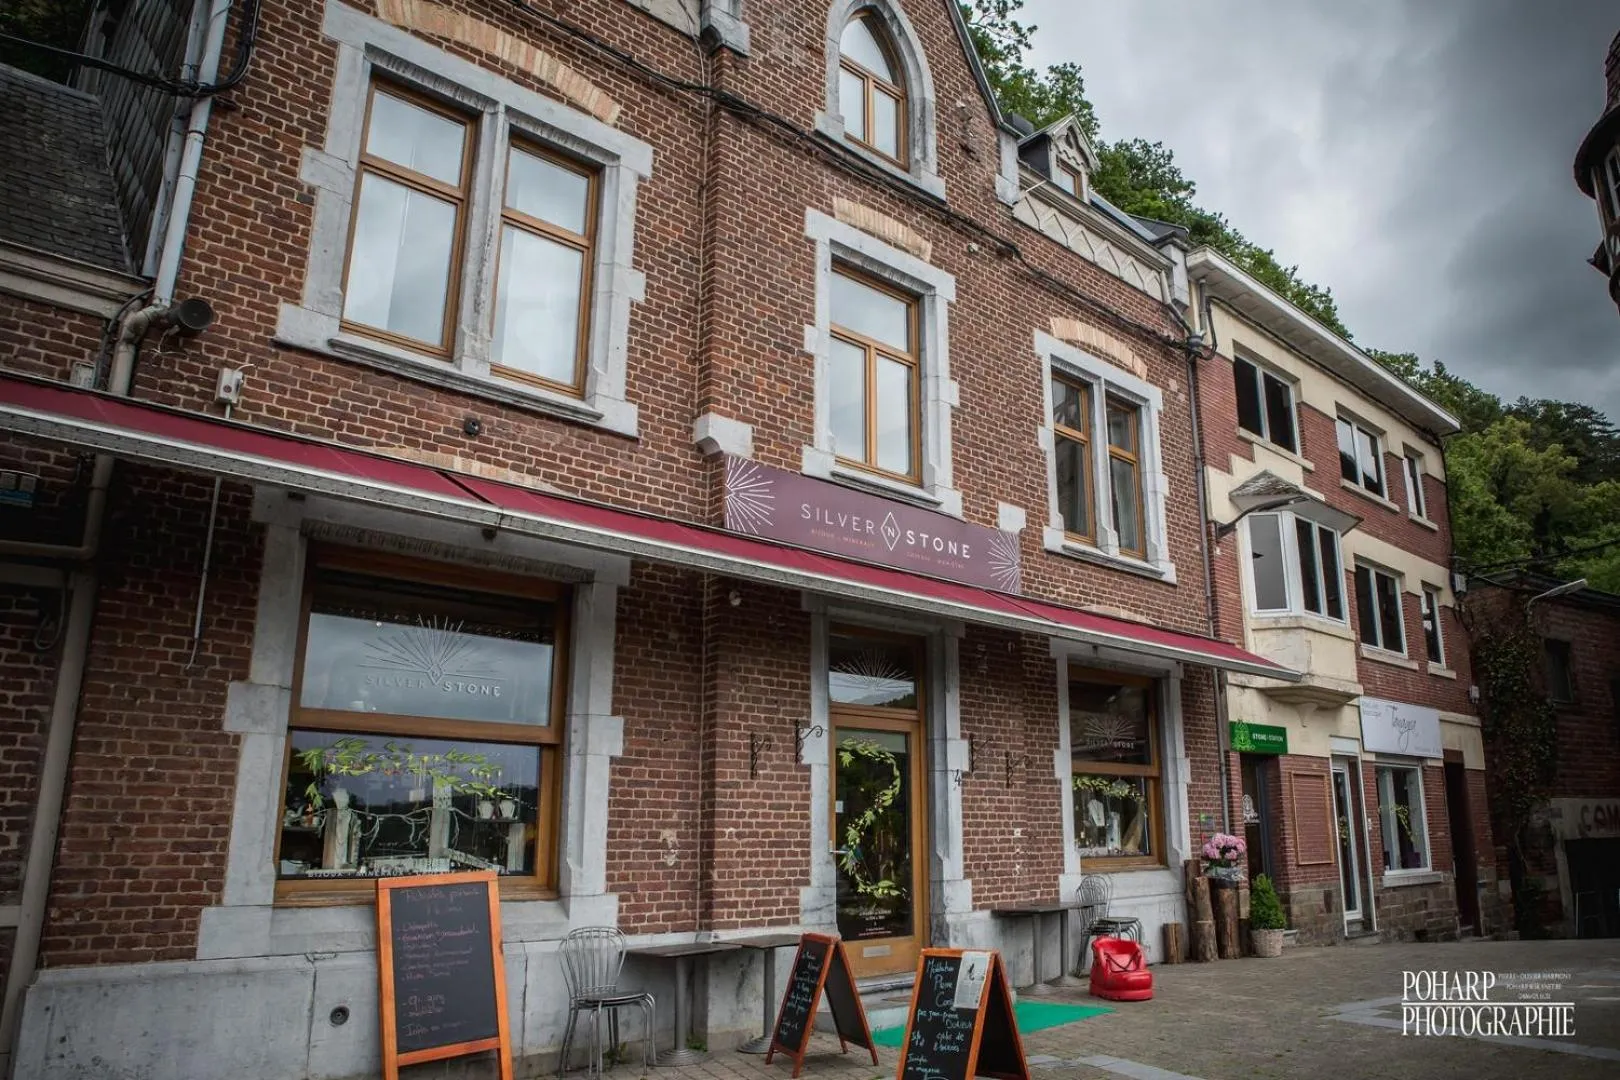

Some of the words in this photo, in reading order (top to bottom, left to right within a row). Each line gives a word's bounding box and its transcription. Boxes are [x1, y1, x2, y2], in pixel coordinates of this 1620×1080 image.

[800, 503, 875, 535] SILVER
[906, 531, 971, 559] STONE
[365, 675, 426, 689] SILVER
[442, 680, 503, 698] STONE
